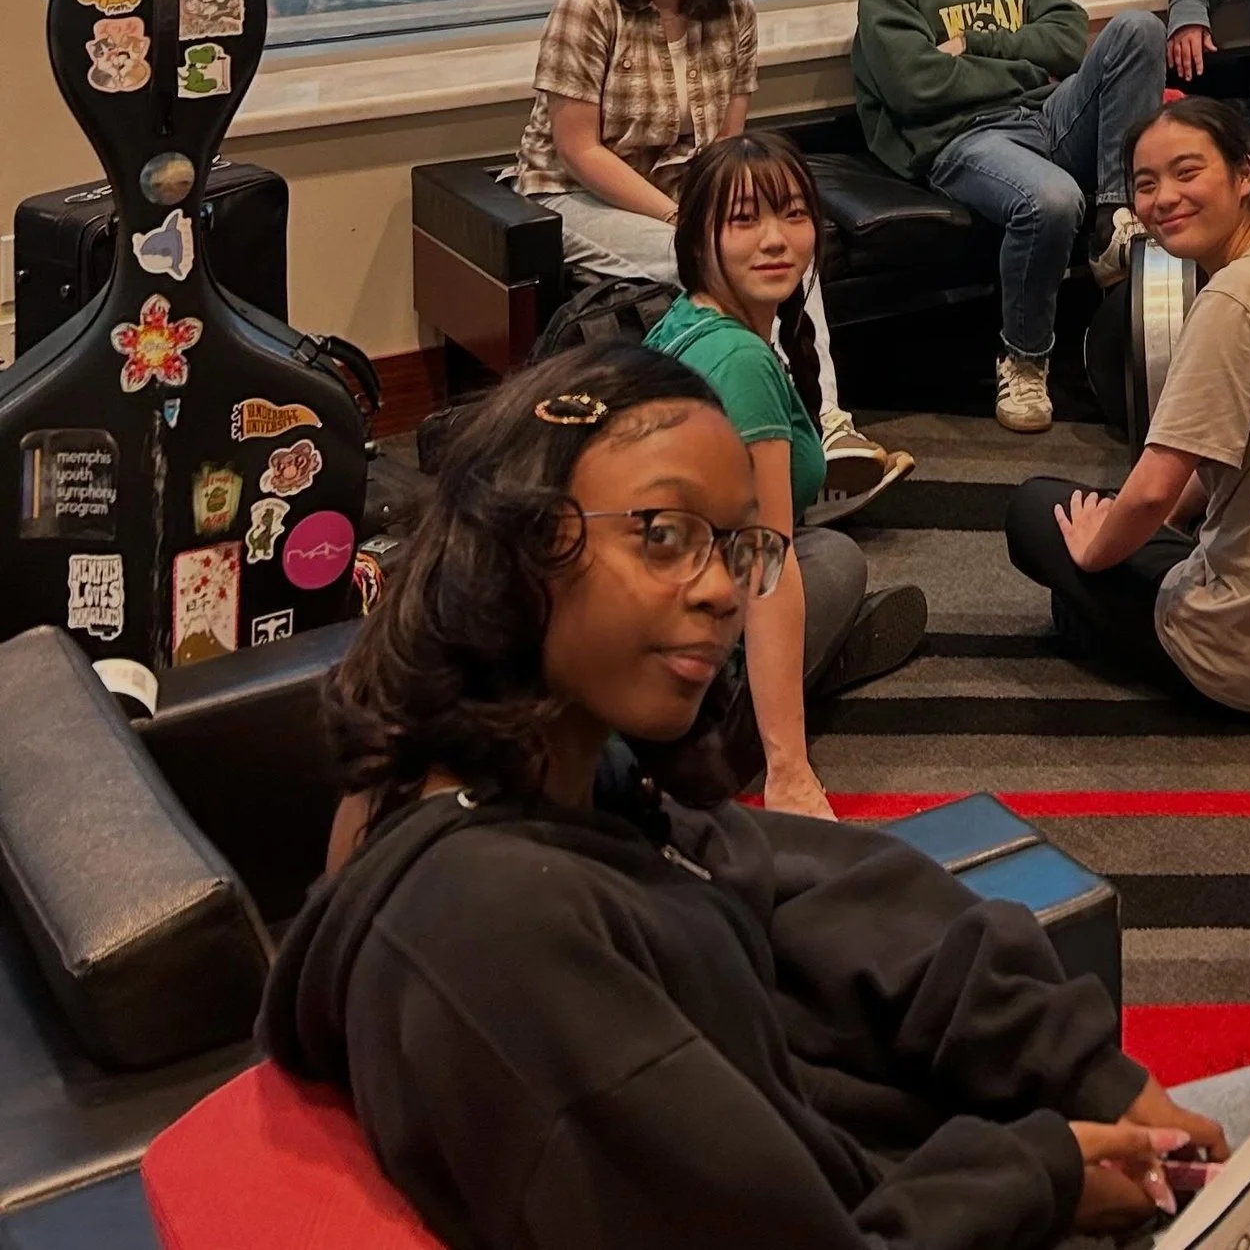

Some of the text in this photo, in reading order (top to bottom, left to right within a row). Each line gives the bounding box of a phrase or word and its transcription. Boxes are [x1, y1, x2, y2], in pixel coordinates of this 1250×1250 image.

[246, 403, 299, 421] VANDERBILT
[245, 417, 302, 434] UNIVERSITY
[56, 449, 112, 467] memphis
[56, 466, 93, 484] youth
[56, 483, 117, 504] symphony
[55, 502, 109, 518] program
[71, 558, 120, 583] MEMPHIS
[70, 580, 121, 608] LOVES
